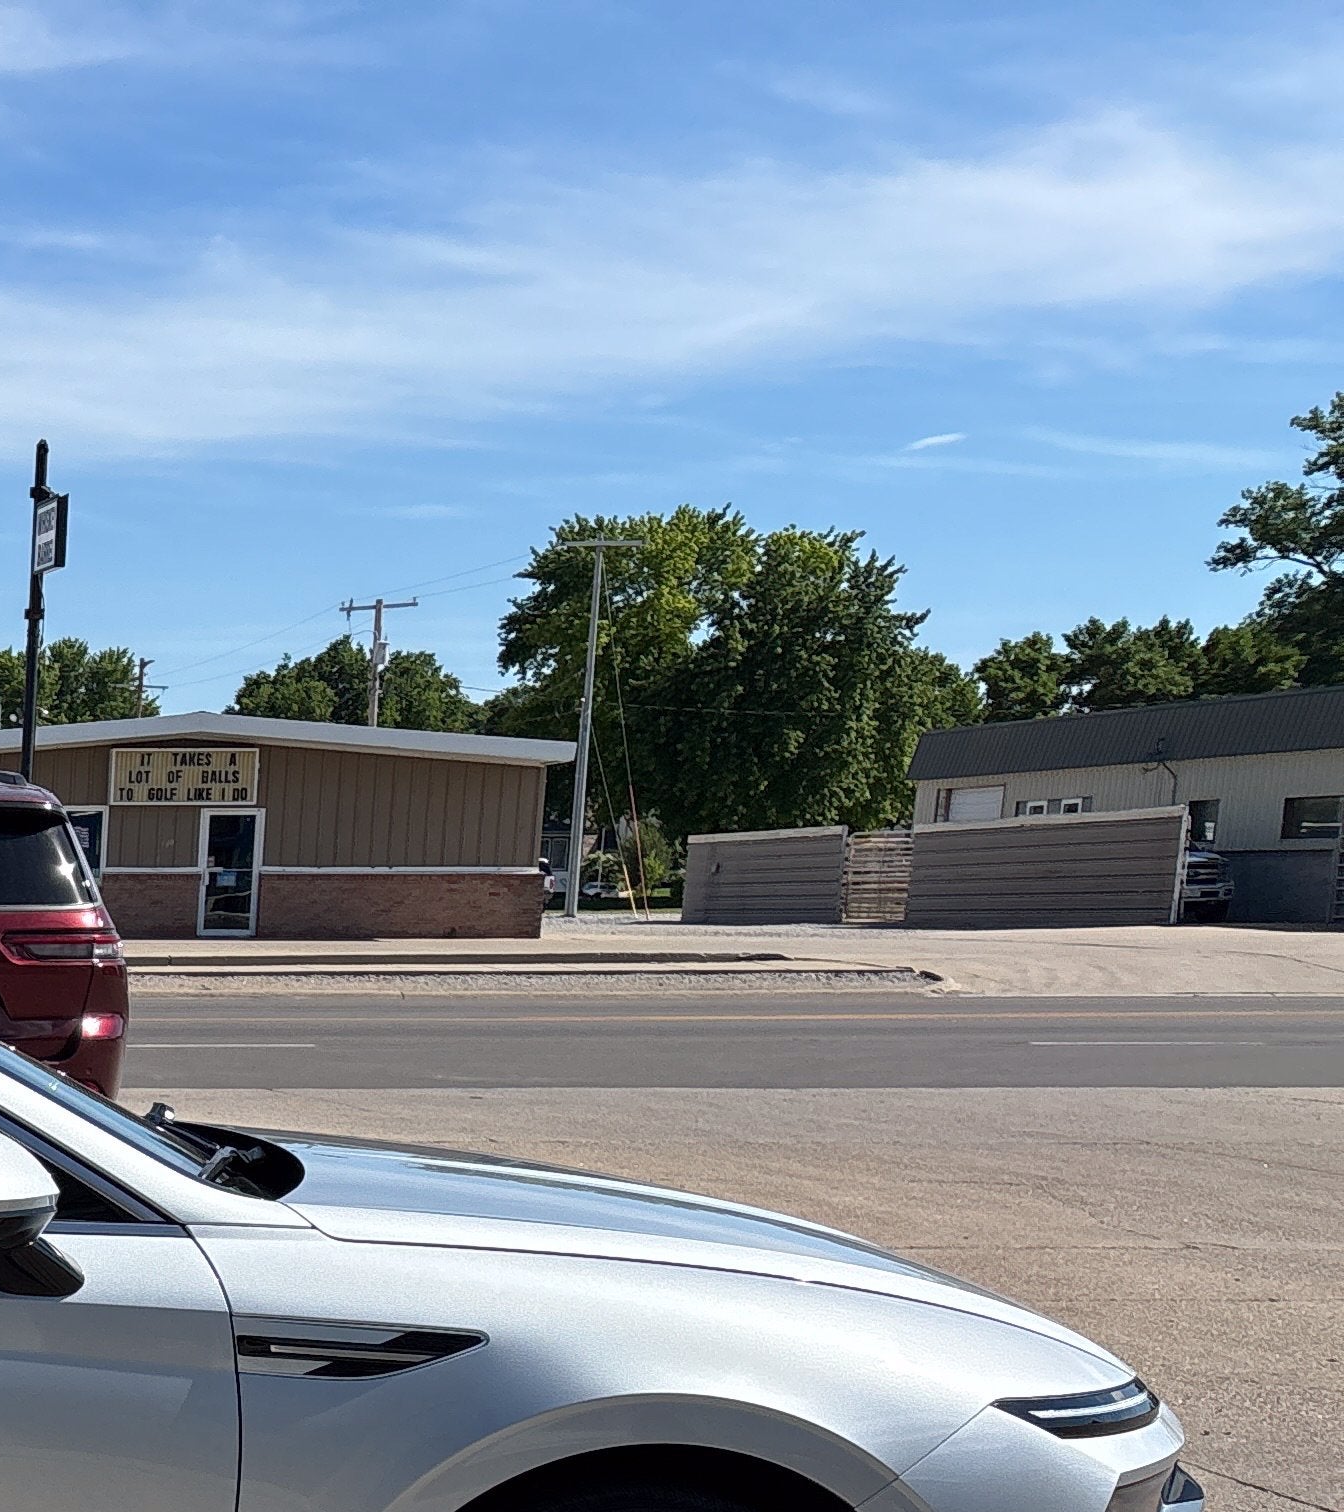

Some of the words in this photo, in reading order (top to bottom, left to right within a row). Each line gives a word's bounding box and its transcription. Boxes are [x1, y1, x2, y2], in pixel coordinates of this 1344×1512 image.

[140, 753, 152, 766] IT
[172, 753, 212, 766] TAKES
[229, 753, 237, 766] A
[129, 770, 151, 784] LOT
[167, 770, 183, 784] OF
[201, 770, 240, 784] BALLS
[119, 788, 134, 801] TO
[148, 788, 178, 801] GOLF
[187, 788, 212, 801] LIKE
[221, 788, 226, 801] I
[232, 788, 248, 801] DO
